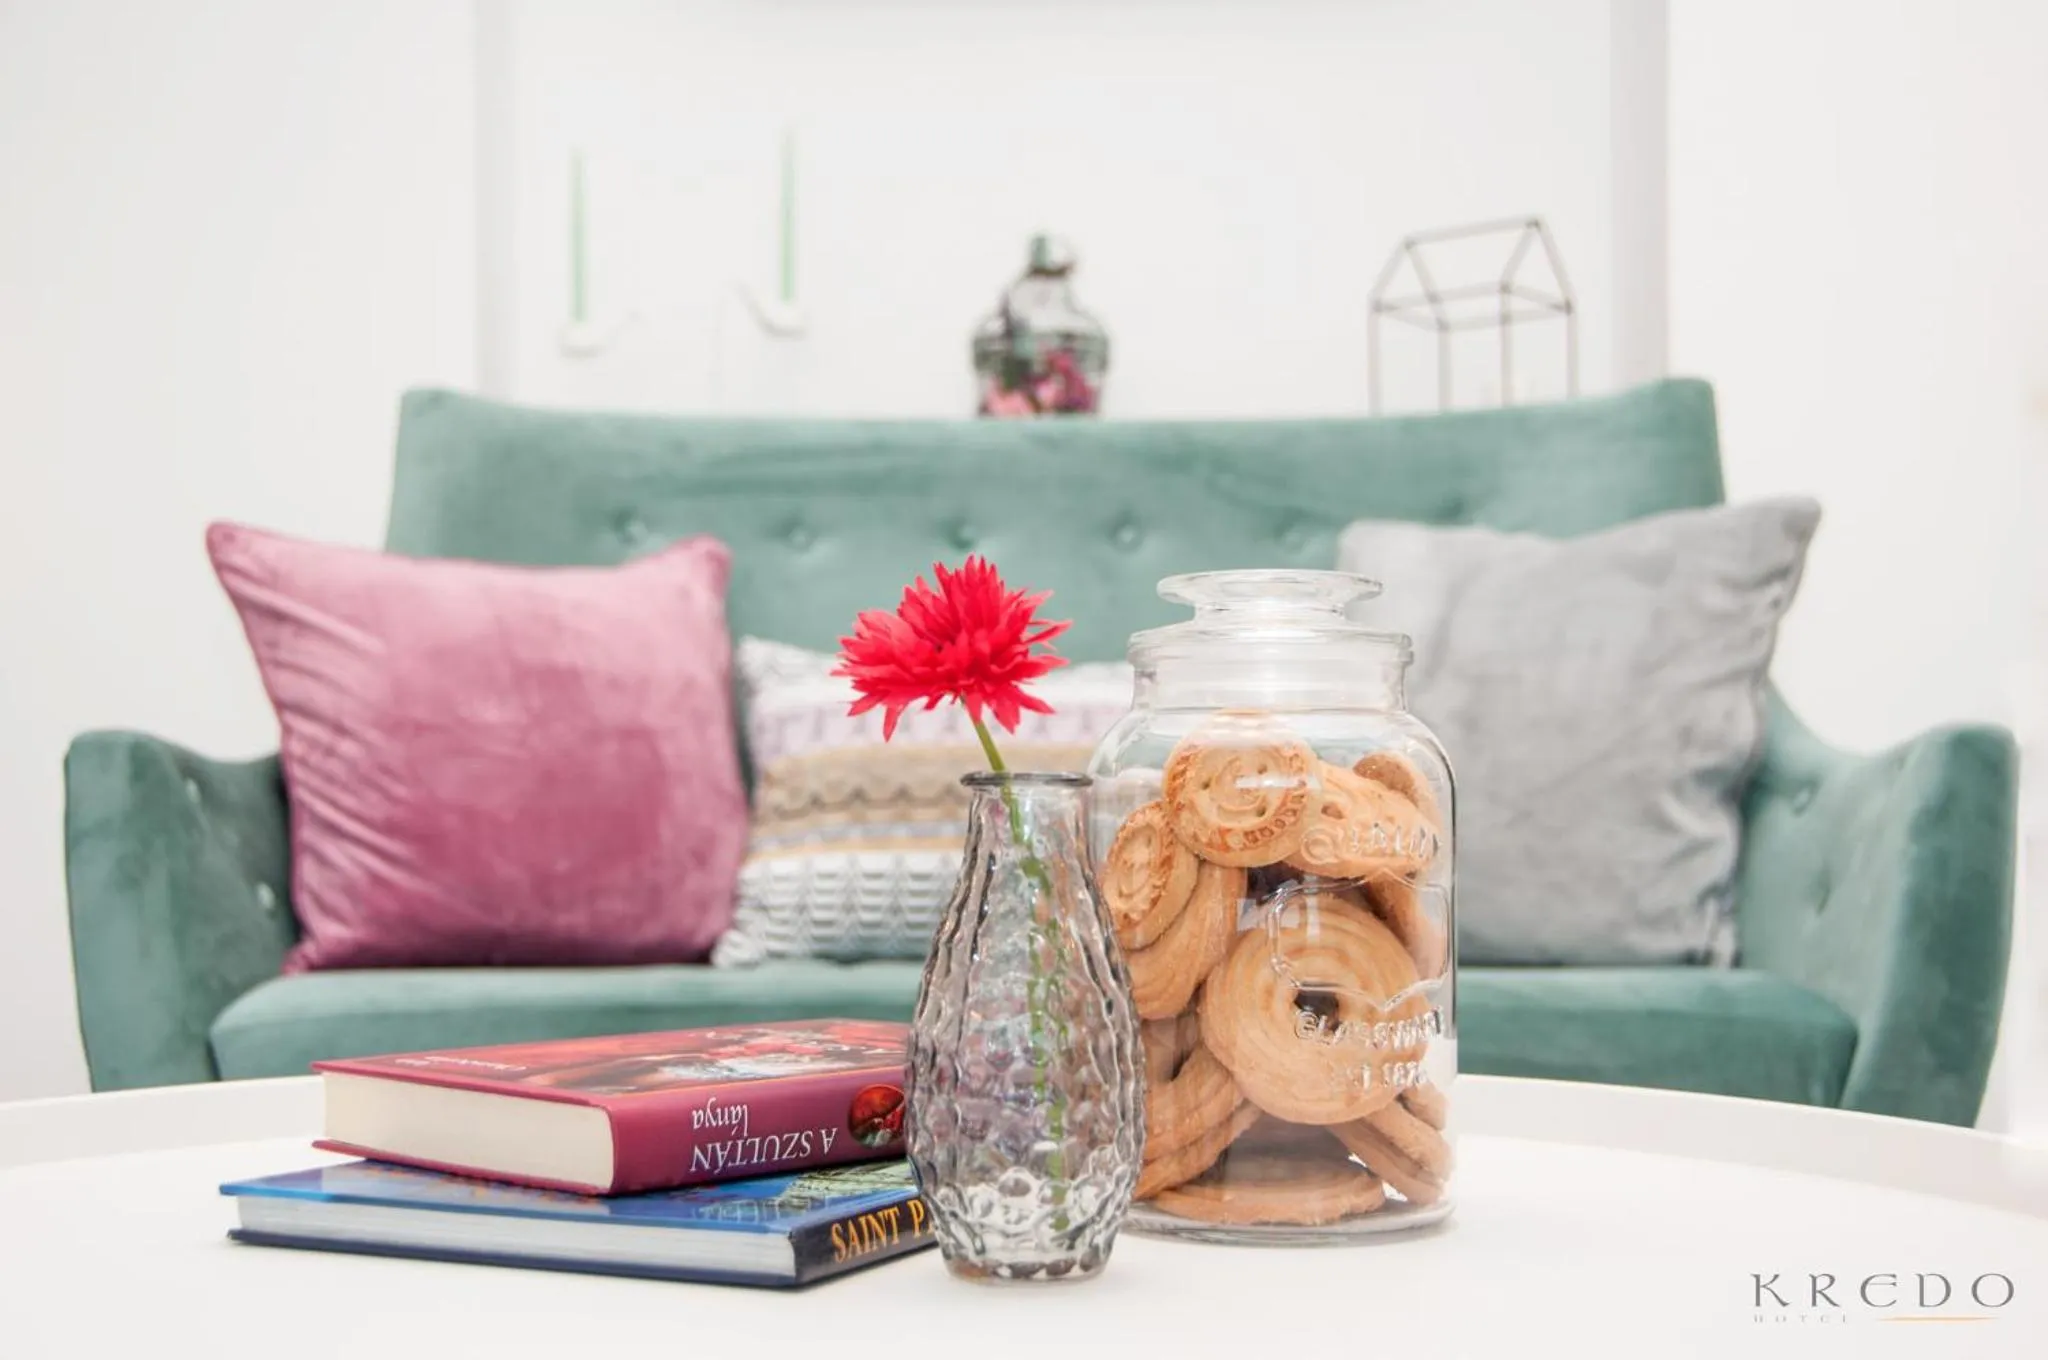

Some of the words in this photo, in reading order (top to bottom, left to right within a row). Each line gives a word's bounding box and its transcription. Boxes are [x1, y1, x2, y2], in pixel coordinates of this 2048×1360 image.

[692, 1097, 748, 1136] lánya
[690, 1130, 813, 1174] SZULTÁN
[820, 1127, 838, 1155] A
[831, 1206, 901, 1264] SAINT
